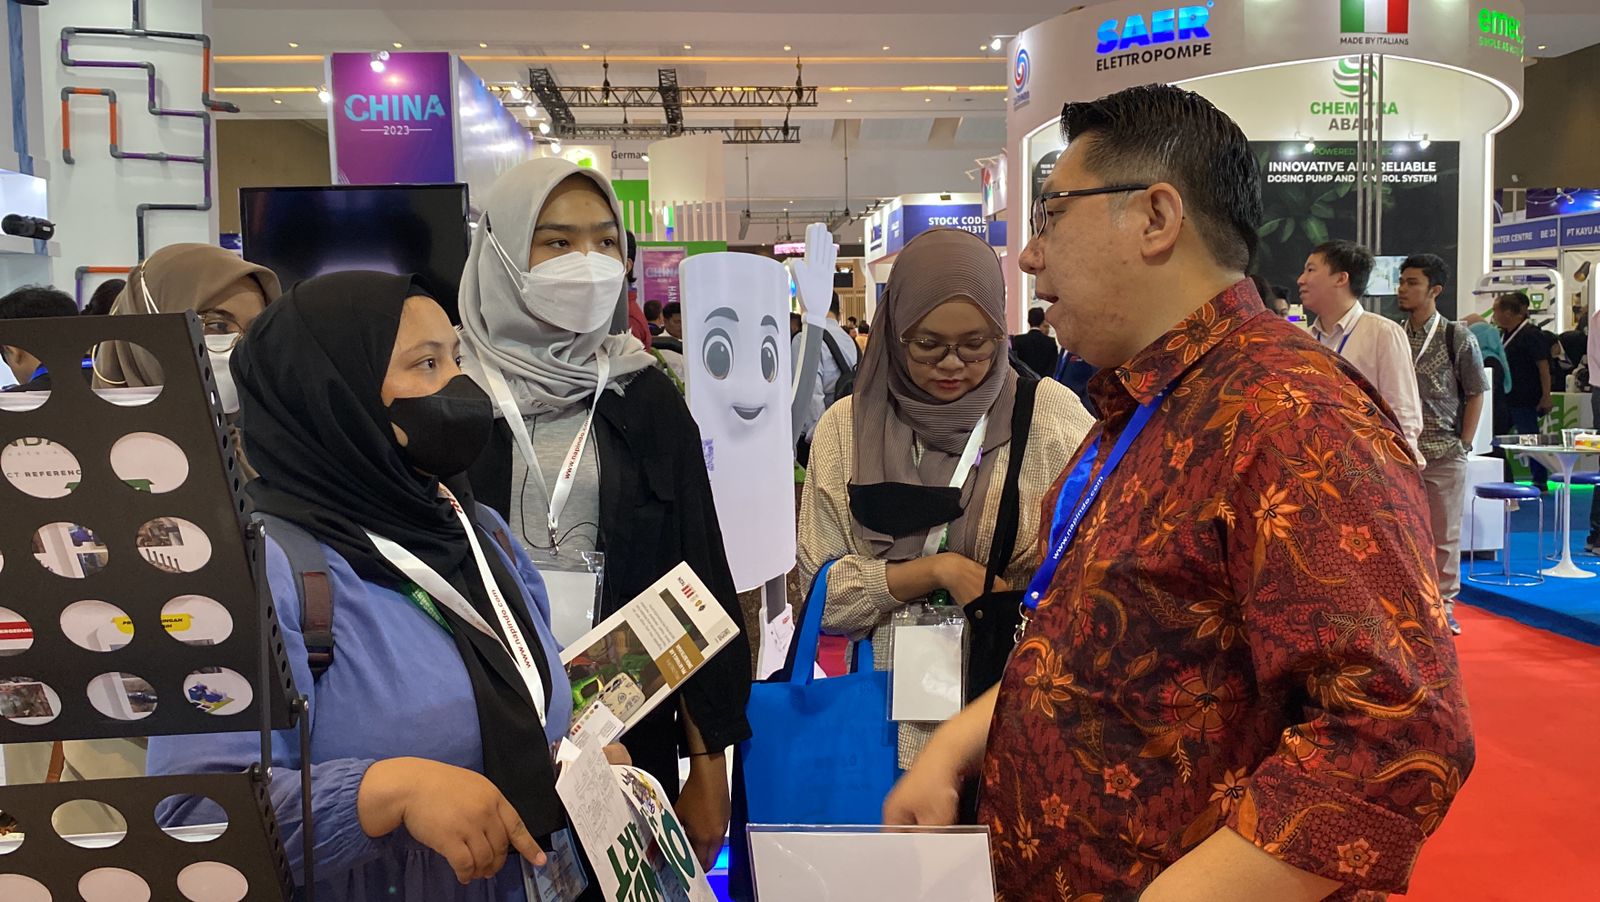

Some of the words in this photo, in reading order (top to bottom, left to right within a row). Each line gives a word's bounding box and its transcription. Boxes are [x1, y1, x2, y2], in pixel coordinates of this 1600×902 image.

[1096, 5, 1211, 54] SAER
[1340, 37, 1363, 45] MADE
[1365, 37, 1375, 45] BY
[1376, 37, 1409, 46] ITALIANS
[1096, 43, 1212, 71] ELETTROPOMPE
[344, 94, 446, 122] CHINA
[1310, 101, 1399, 115] CHEMTRA
[383, 125, 410, 135] 2023
[1268, 161, 1345, 172] INNOVATIVE
[1381, 161, 1437, 172] RELIABLE
[1267, 174, 1304, 183] DOSING
[1305, 174, 1333, 183] PUMP
[1334, 174, 1356, 183] AND
[1402, 174, 1438, 183] SYSTEM
[928, 216, 959, 226] STOCK
[961, 216, 987, 225] CODE
[1511, 231, 1533, 242] CENTRE
[1540, 229, 1548, 239] BE
[1566, 227, 1575, 237] PT
[1576, 225, 1592, 236] KAYU
[1052, 475, 1104, 560] www.napindo.com
[491, 588, 532, 669] www.napindo.com
